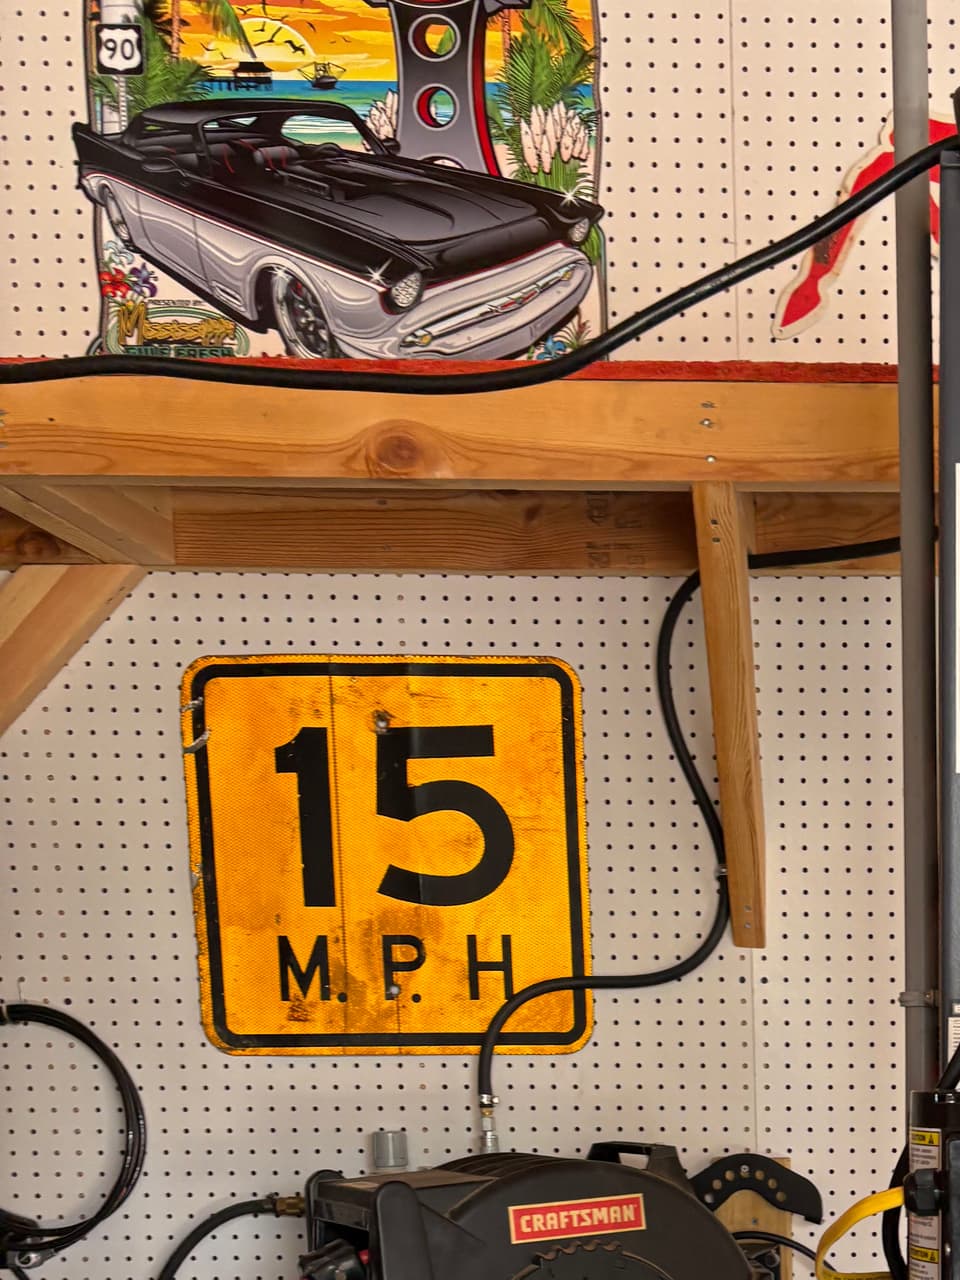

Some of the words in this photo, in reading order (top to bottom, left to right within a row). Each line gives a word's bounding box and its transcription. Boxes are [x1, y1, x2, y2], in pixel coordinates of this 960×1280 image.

[104, 39, 134, 60] 90
[275, 725, 515, 906] 15
[520, 1204, 636, 1233] CRAFTSMAN
